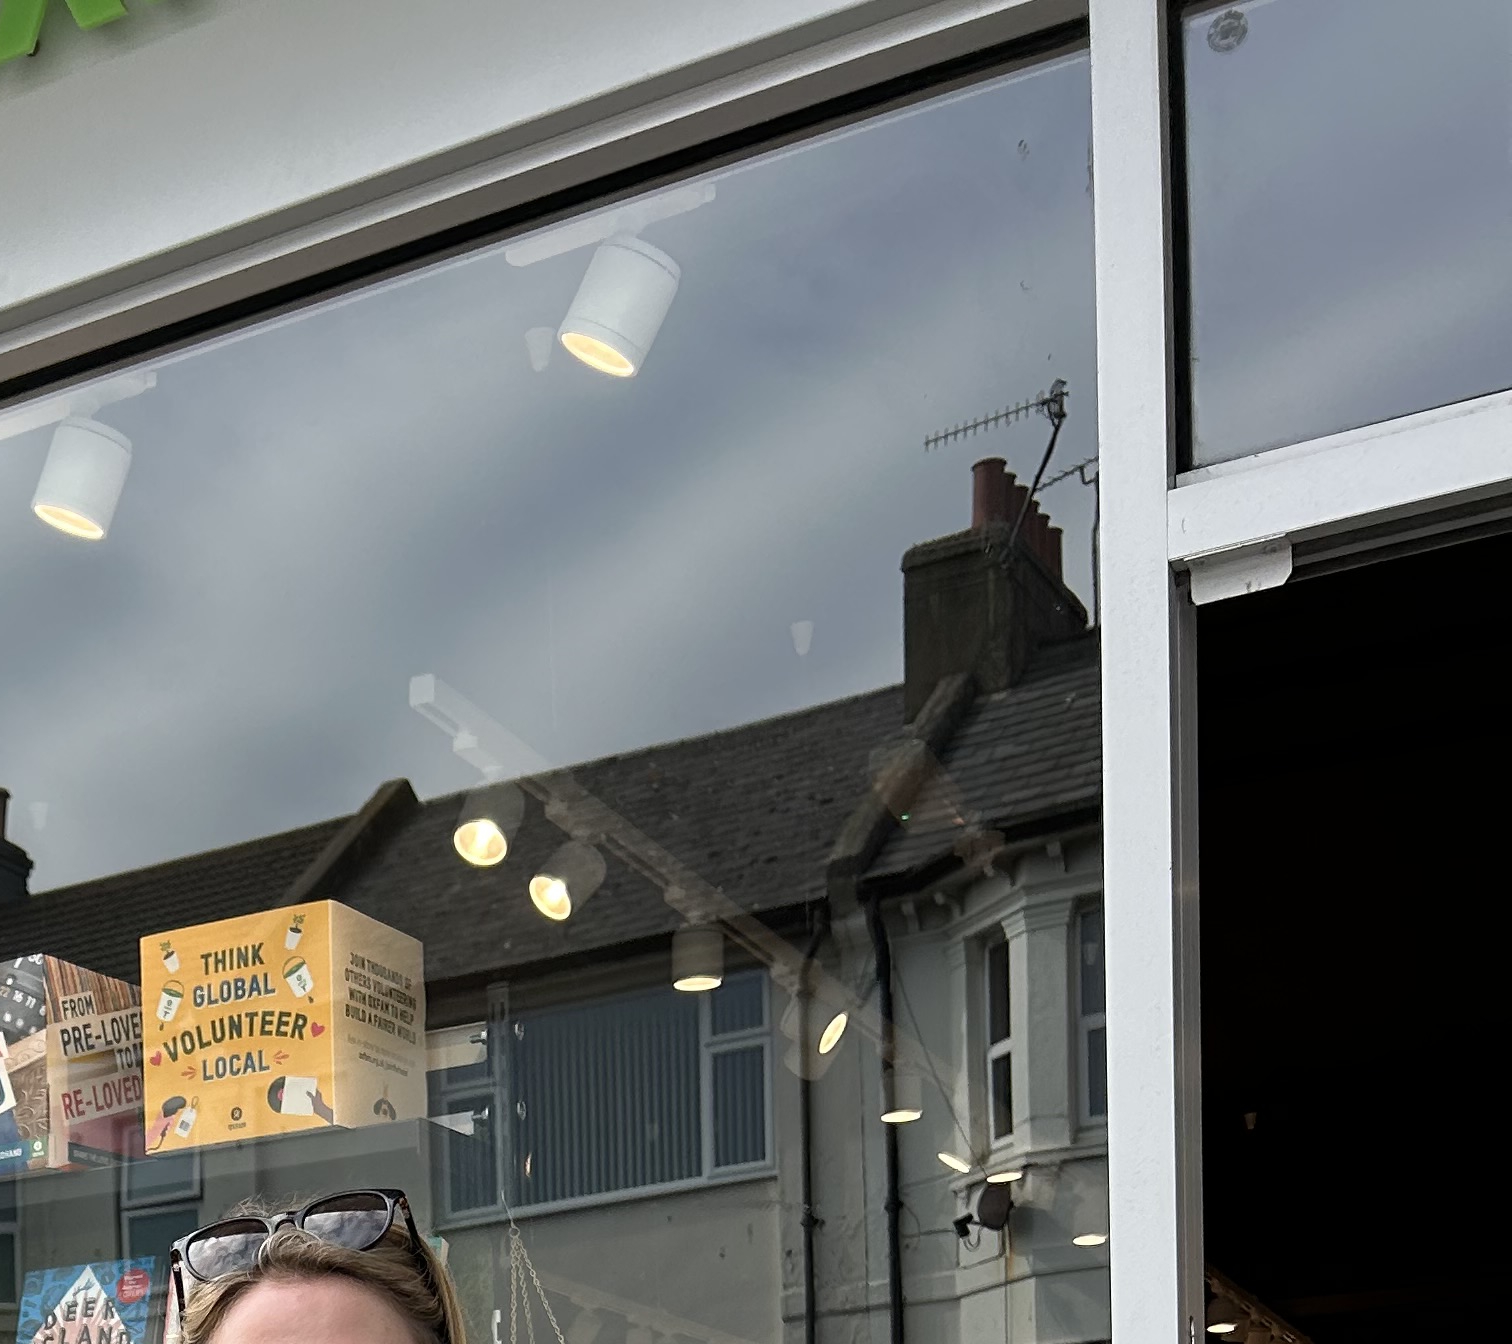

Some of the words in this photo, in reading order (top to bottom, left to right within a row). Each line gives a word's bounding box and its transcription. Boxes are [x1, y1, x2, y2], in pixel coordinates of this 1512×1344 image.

[200, 942, 265, 976] THINK
[192, 972, 276, 1008] GLOBAL
[162, 1010, 308, 1063] VOLUNTEER
[202, 1050, 270, 1081] LOCAL
[44, 1297, 118, 1331] DEER
